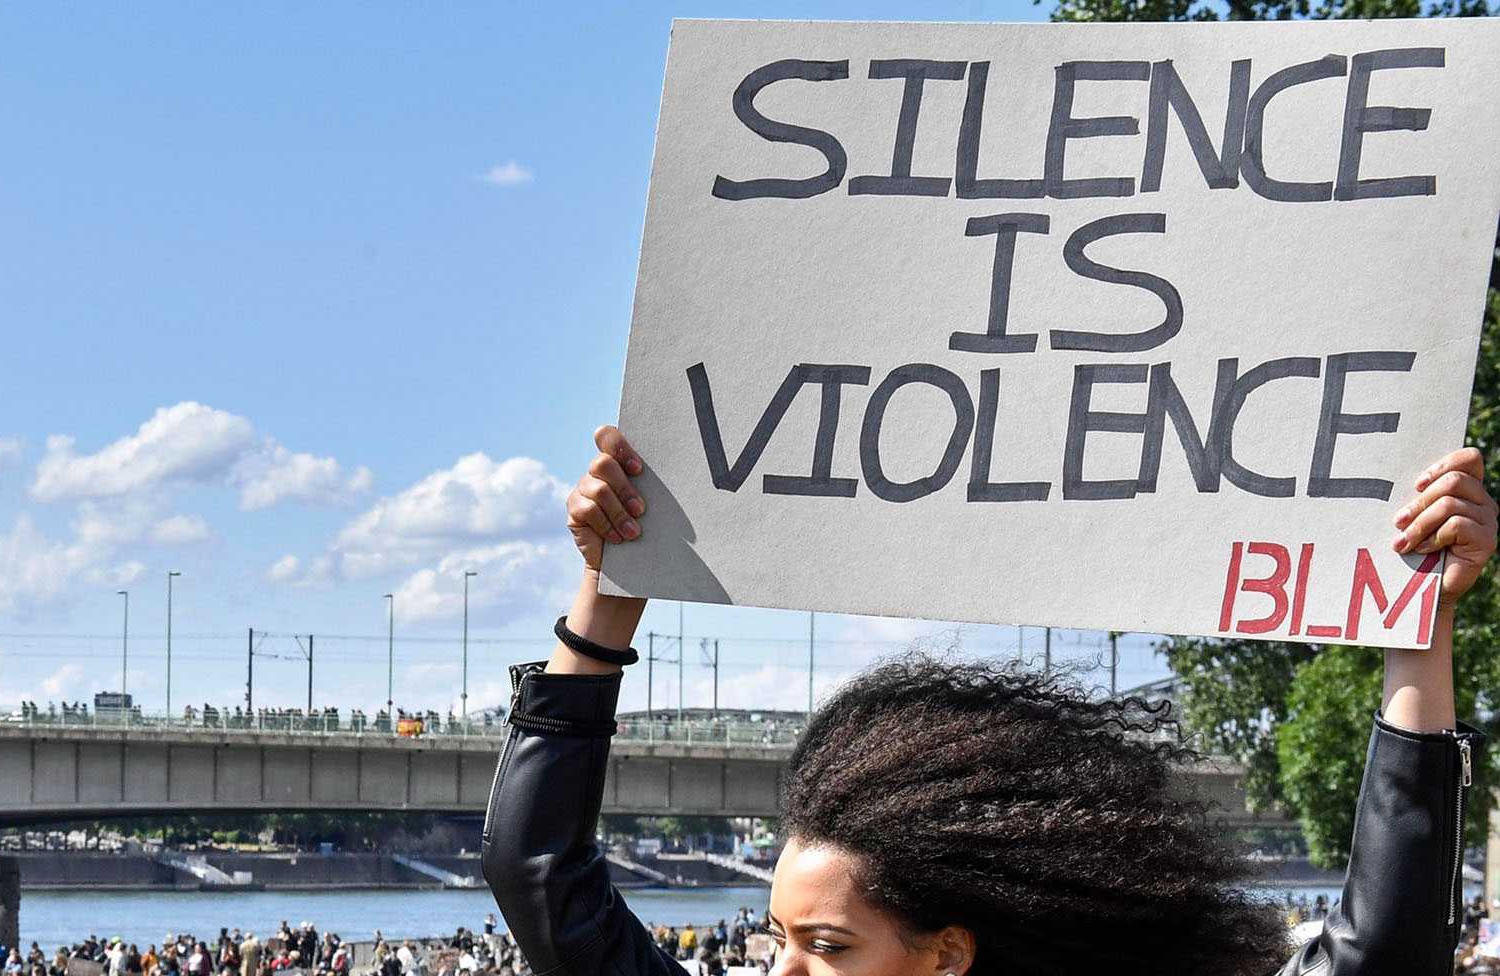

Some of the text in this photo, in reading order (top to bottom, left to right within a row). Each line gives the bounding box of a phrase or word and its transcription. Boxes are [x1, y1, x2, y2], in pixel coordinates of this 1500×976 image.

[712, 47, 1446, 203] SILENCE
[949, 213, 1185, 354] IS
[686, 352, 1417, 503] VIOLENCE
[1219, 540, 1442, 645] BLM
